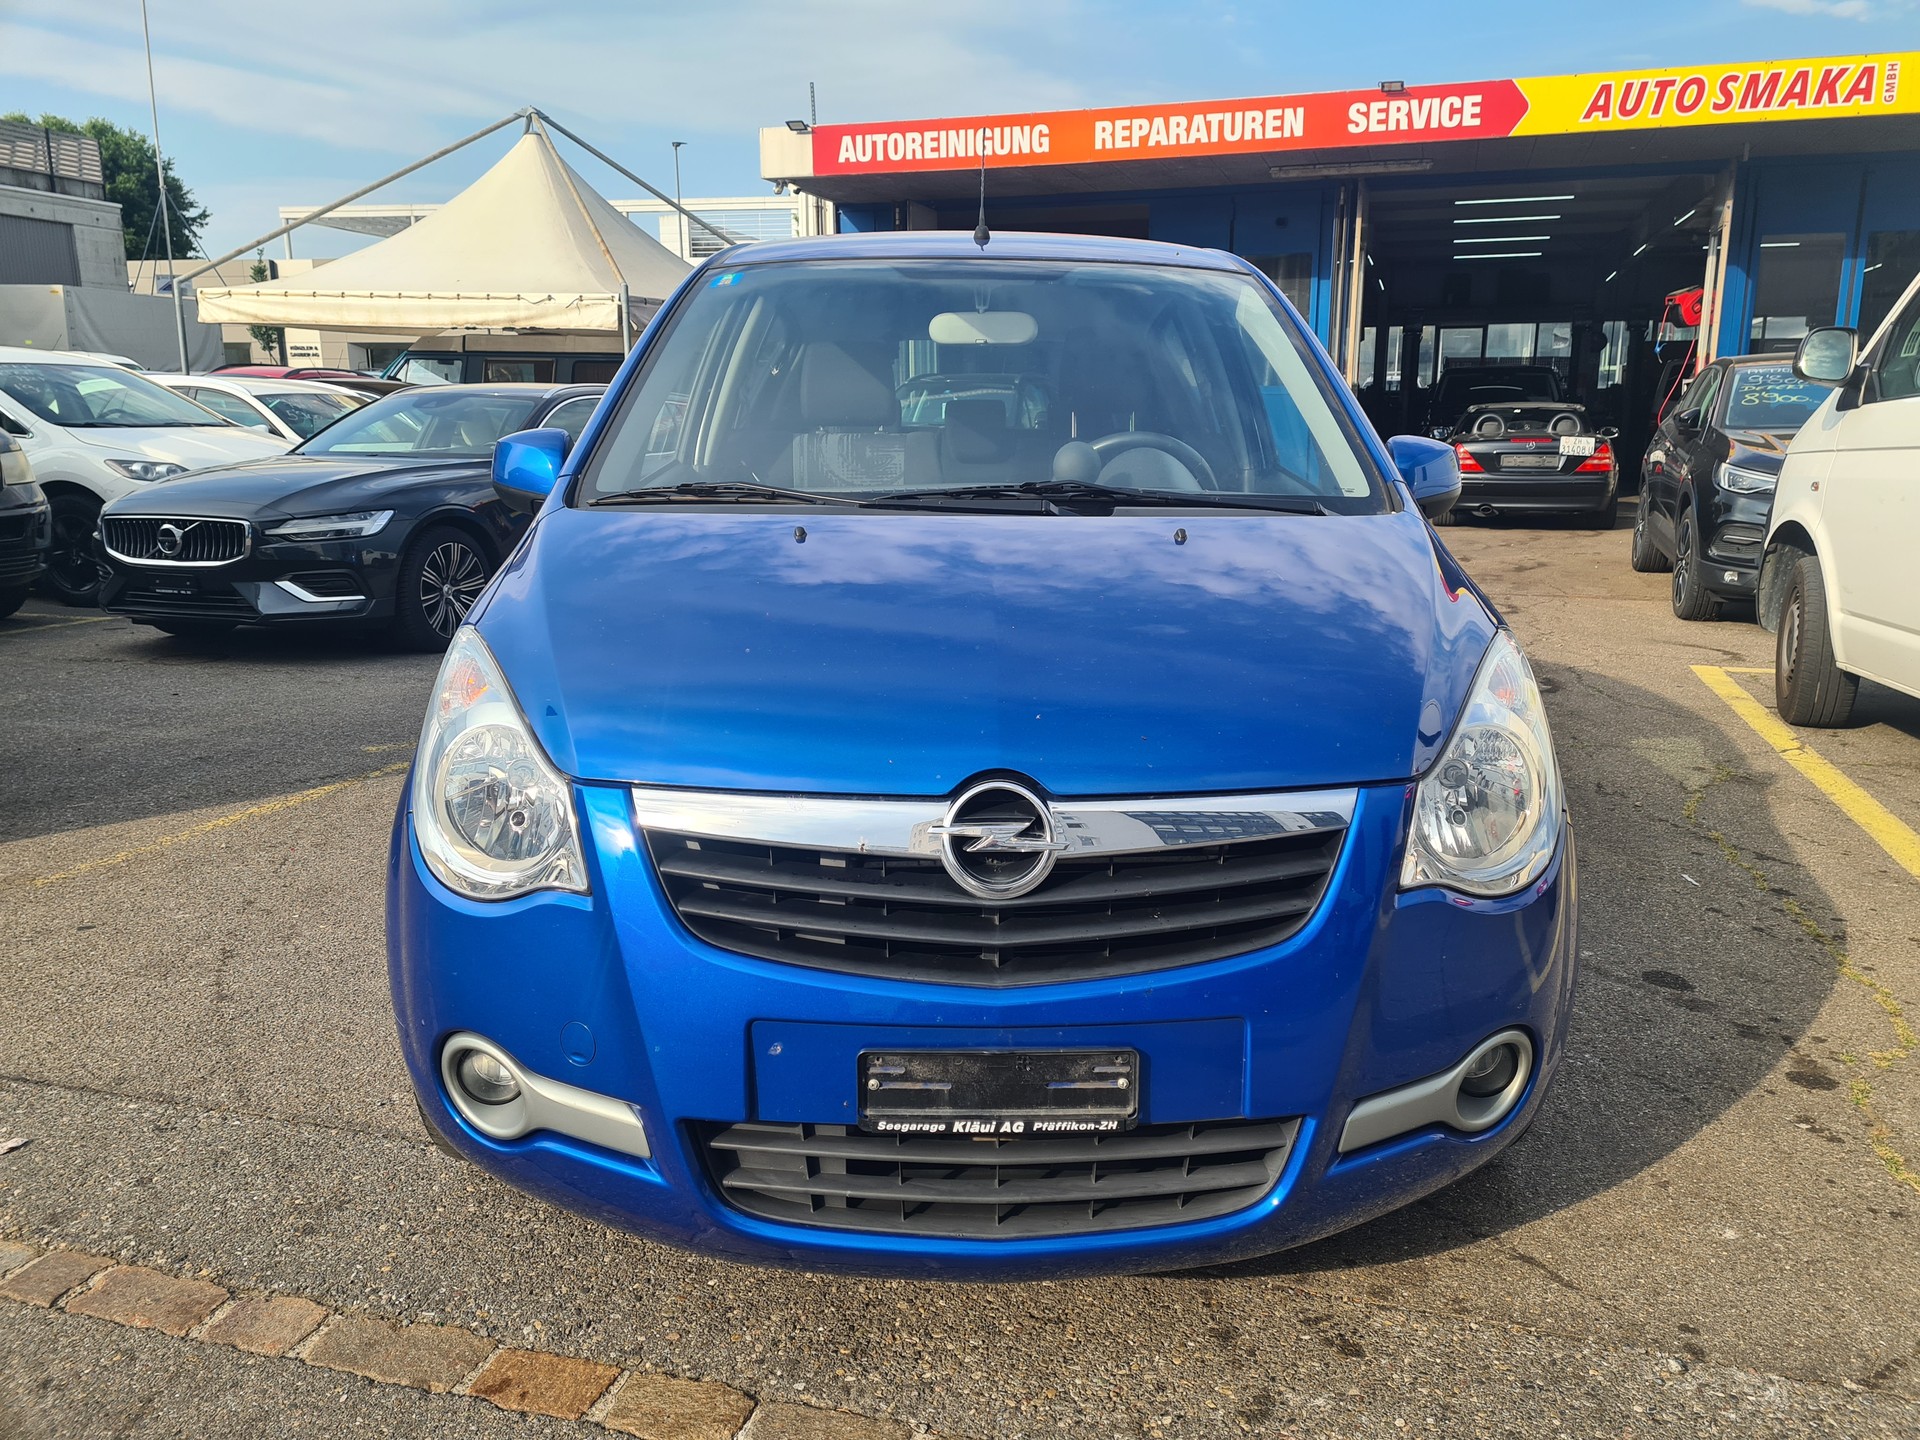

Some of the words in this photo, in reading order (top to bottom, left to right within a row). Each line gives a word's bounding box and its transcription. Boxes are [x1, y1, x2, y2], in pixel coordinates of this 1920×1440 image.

[1581, 76, 1706, 122] AUTO
[1712, 63, 1876, 114] SMAKA
[1884, 62, 1899, 103] GMBH
[838, 124, 1050, 163] AUTOREINIGUNG
[1094, 107, 1304, 150] REPARATUREN
[1347, 95, 1483, 133] SERVICE
[877, 1121, 946, 1132] Seegarage
[952, 1121, 996, 1133] Kläui
[999, 1122, 1024, 1133] AG
[1033, 1121, 1118, 1132] Pfäffikon-ZH
